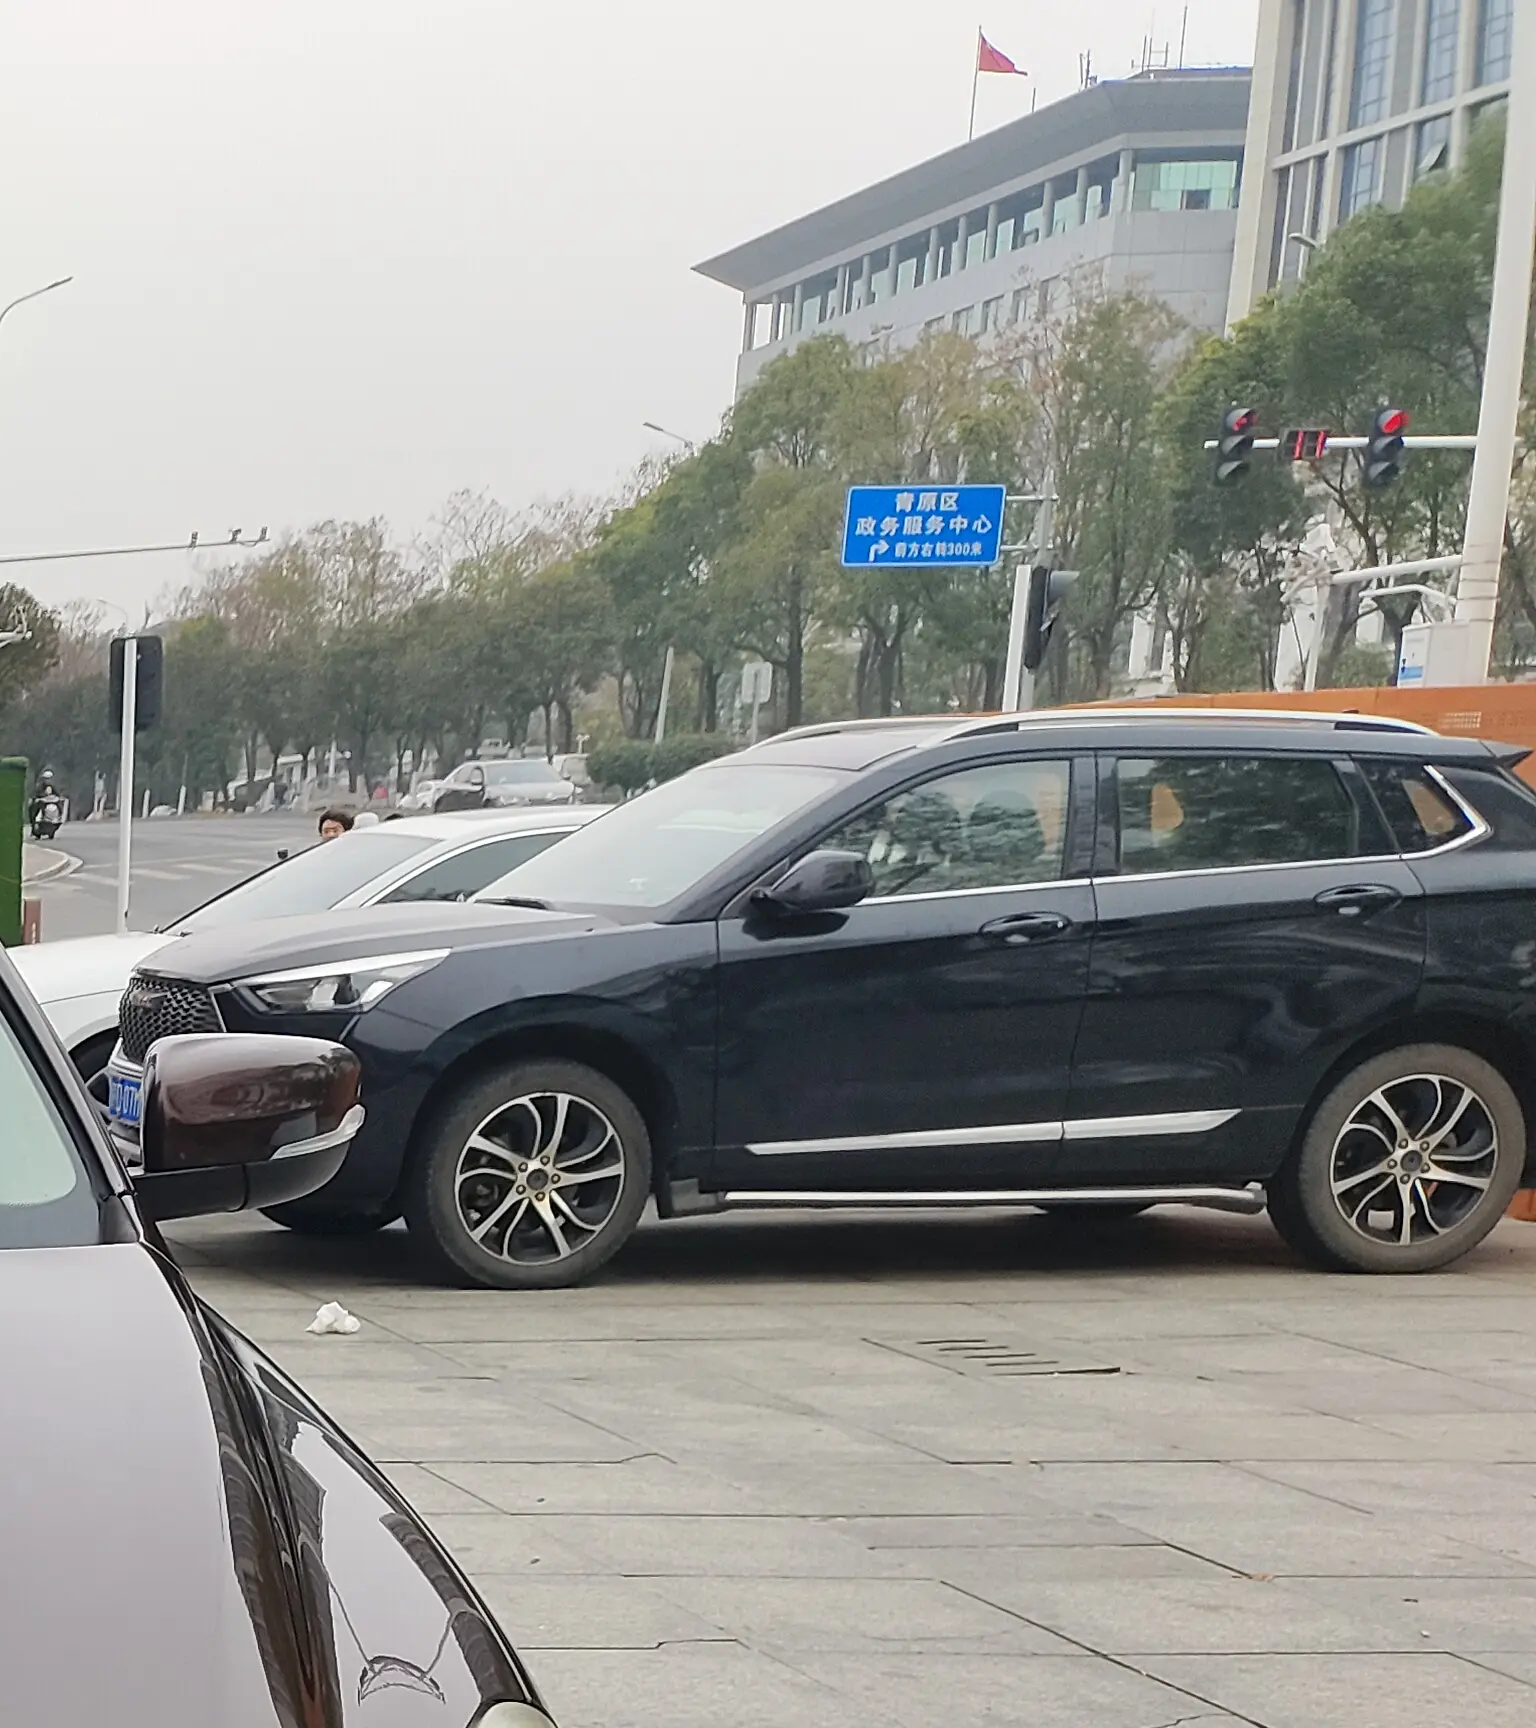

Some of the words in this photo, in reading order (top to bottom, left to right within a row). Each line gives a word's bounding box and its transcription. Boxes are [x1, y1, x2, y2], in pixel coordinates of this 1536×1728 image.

[895, 491, 959, 513] 青原区
[855, 514, 993, 536] 政务服务中心
